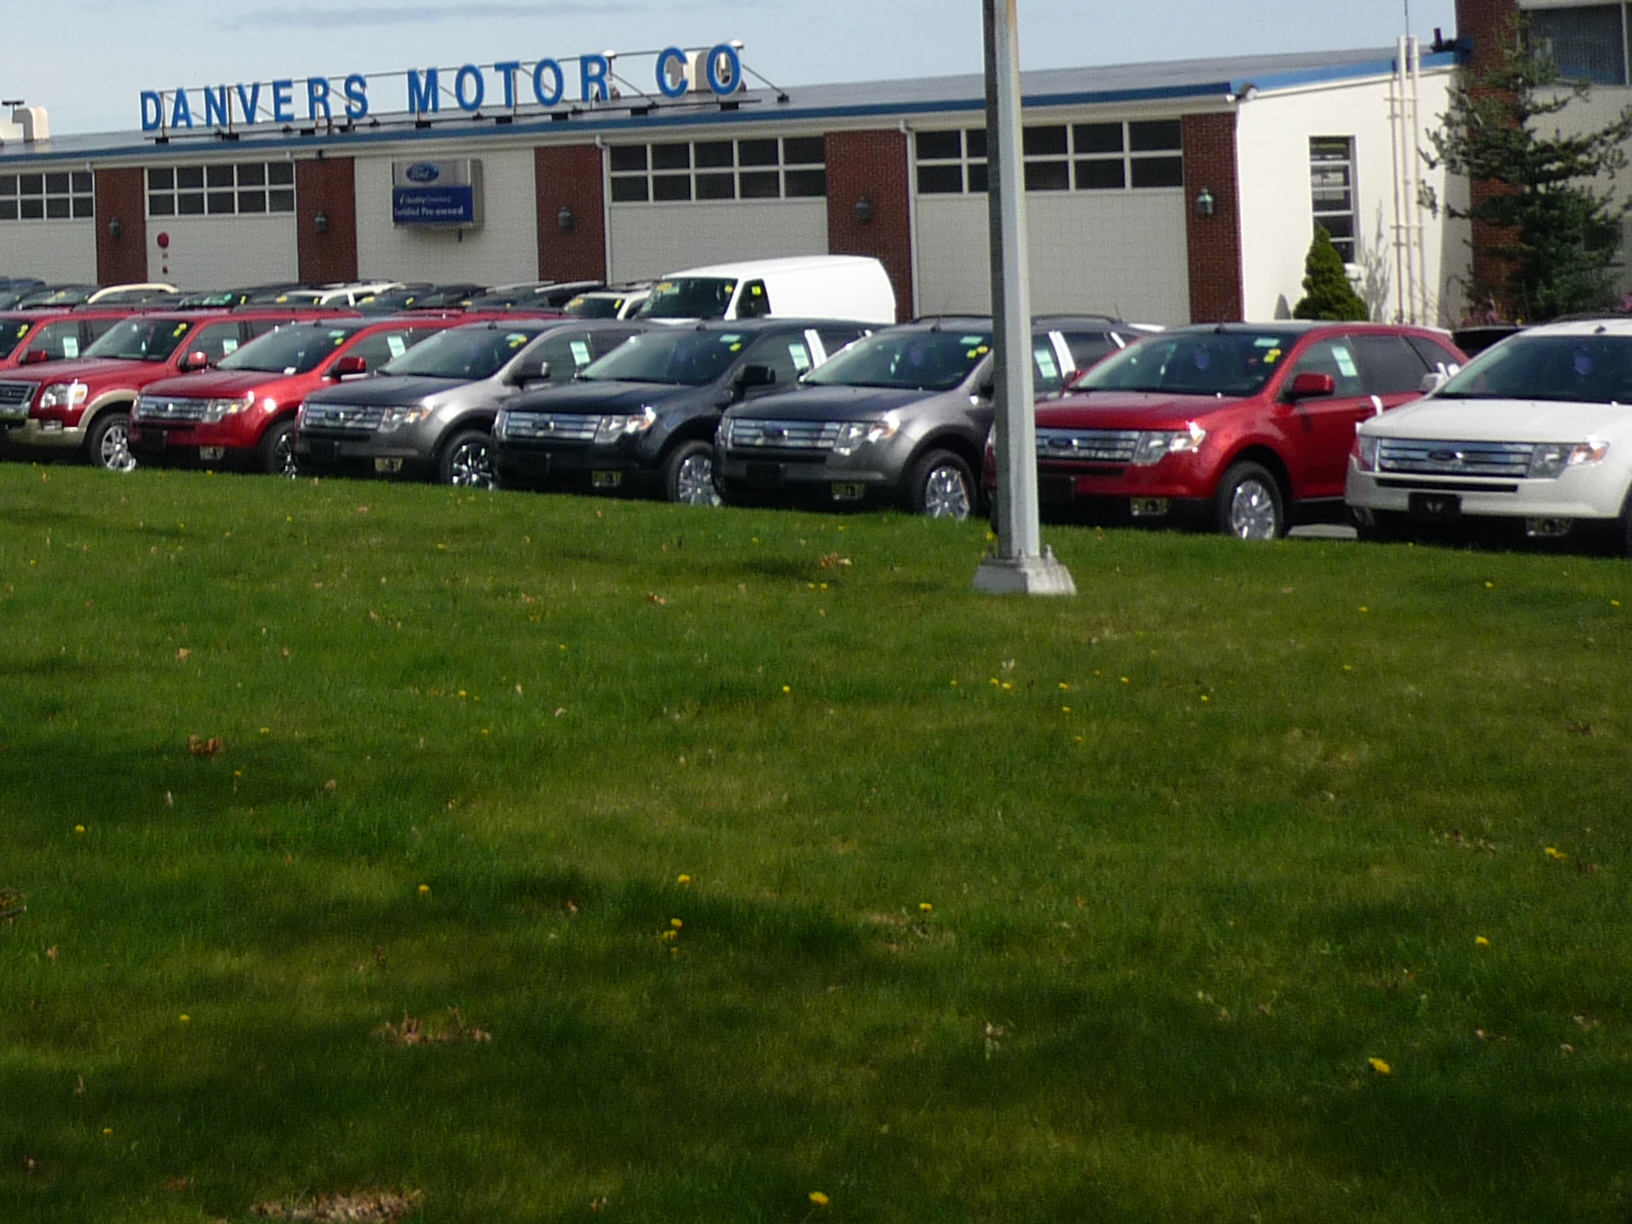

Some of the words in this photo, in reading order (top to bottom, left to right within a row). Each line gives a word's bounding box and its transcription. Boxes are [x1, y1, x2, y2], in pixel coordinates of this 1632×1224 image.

[139, 73, 369, 132] DANVERS
[407, 53, 610, 114] MOTOR
[655, 43, 742, 99] CO
